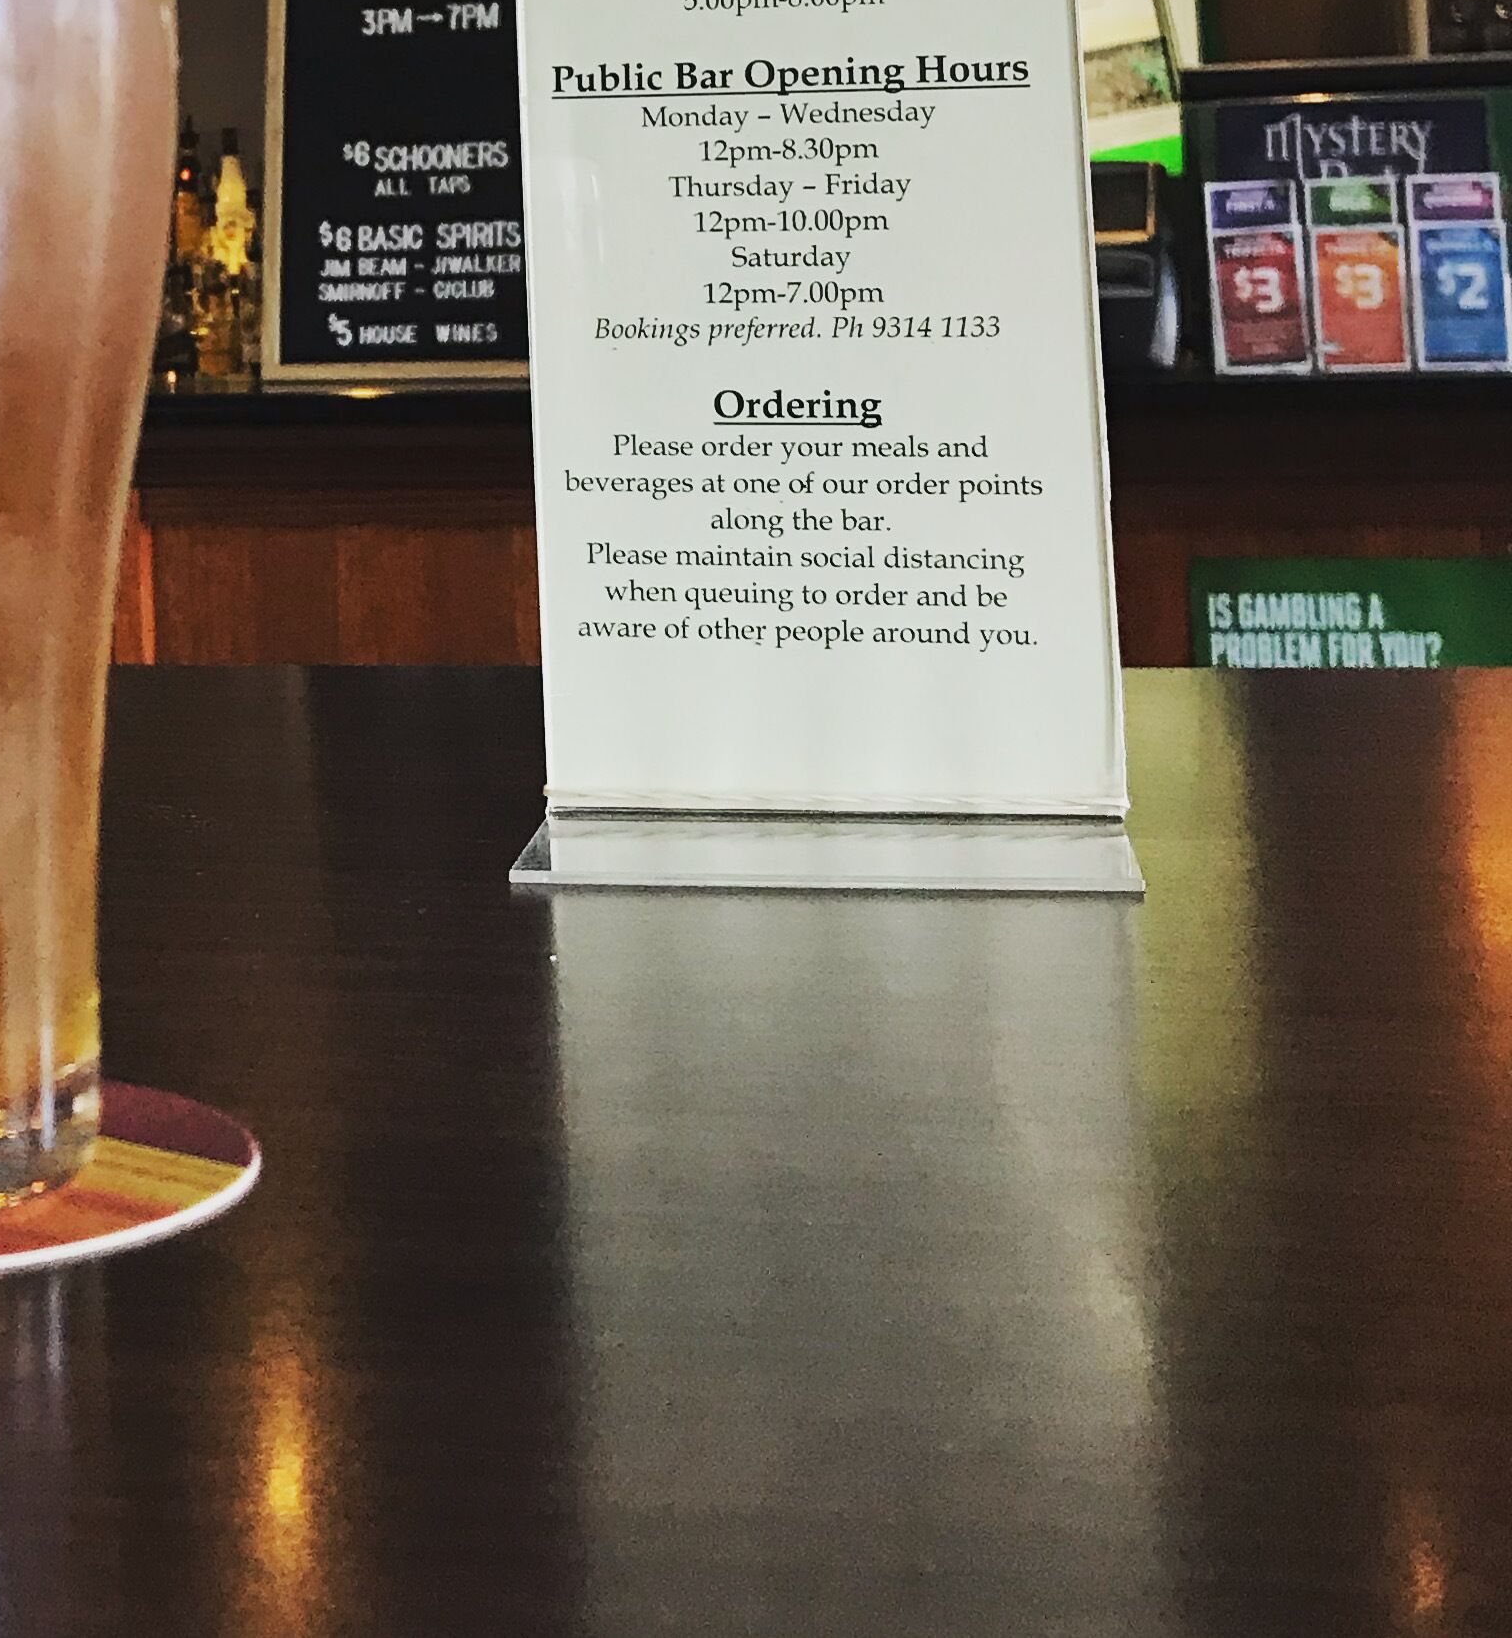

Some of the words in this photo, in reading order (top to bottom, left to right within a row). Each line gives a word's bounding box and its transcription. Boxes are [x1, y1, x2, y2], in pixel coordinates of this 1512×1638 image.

[362, 9, 413, 35] 3PM
[447, 3, 501, 31] 7PM
[552, 62, 662, 93] Public
[676, 61, 733, 90] Bar
[745, 58, 905, 94] Opening
[917, 55, 1029, 83] Hours
[641, 105, 749, 132] Monday
[780, 100, 936, 128] Wednesday
[343, 141, 369, 167] $6
[375, 141, 509, 172] SCHOONERS
[699, 139, 879, 168] 12pm-8.30pm
[374, 178, 411, 196] ALL
[429, 176, 471, 194] TAPS
[668, 175, 794, 202] Thursday
[825, 174, 911, 201] Friday
[319, 222, 352, 252] $6
[358, 224, 423, 252] BASIC
[437, 222, 521, 249] SPIRITS
[694, 210, 889, 239] 12pm-10.00pm
[320, 259, 351, 276] JIM
[358, 257, 406, 276] BEAM
[731, 246, 851, 274] Saturday
[318, 282, 405, 301] SMIRNOFF
[703, 282, 884, 311] 12pm-7.00pm
[1234, 266, 1286, 313] $3
[1336, 264, 1385, 309] $3
[1438, 262, 1489, 310] $2
[329, 314, 352, 346] $5
[359, 325, 417, 344] HOUSE
[435, 323, 497, 343] WINES
[595, 317, 700, 347] Bookings
[709, 317, 821, 344] preferred.
[832, 317, 864, 339] Ph
[873, 316, 931, 338] 9314
[941, 316, 1001, 338] 1133
[713, 389, 882, 428] Ordering
[613, 434, 693, 458] Please
[702, 435, 773, 457] order
[781, 439, 843, 465] your
[851, 436, 929, 458] meals
[937, 436, 988, 459] and
[565, 470, 694, 499] beverages
[702, 475, 725, 493] at
[733, 476, 780, 494] one
[789, 471, 815, 494] of
[823, 478, 868, 496] our
[876, 472, 950, 496] order
[958, 475, 1043, 502] points
[710, 508, 784, 537] along
[793, 509, 833, 532] the
[842, 509, 892, 533] bar.
[586, 543, 668, 567] Please
[675, 545, 793, 569] maintain
[801, 546, 874, 569] social
[884, 547, 1025, 577] distancing
[606, 582, 677, 603] when
[685, 584, 794, 610] queuing
[802, 586, 827, 606] to
[836, 584, 909, 608] order
[916, 585, 967, 608] and
[977, 585, 1008, 608] be
[1209, 594, 1232, 628] IS
[1237, 594, 1362, 628] GAMBLING
[1367, 594, 1385, 626] A
[577, 619, 657, 639] aware
[664, 617, 692, 639] of
[698, 617, 767, 642] other
[775, 619, 865, 650] people
[872, 621, 970, 646] around
[979, 627, 1038, 652] you.
[1210, 632, 1322, 667] PROBLEM
[1328, 632, 1375, 667] FOR
[1380, 631, 1444, 667] YOU?
